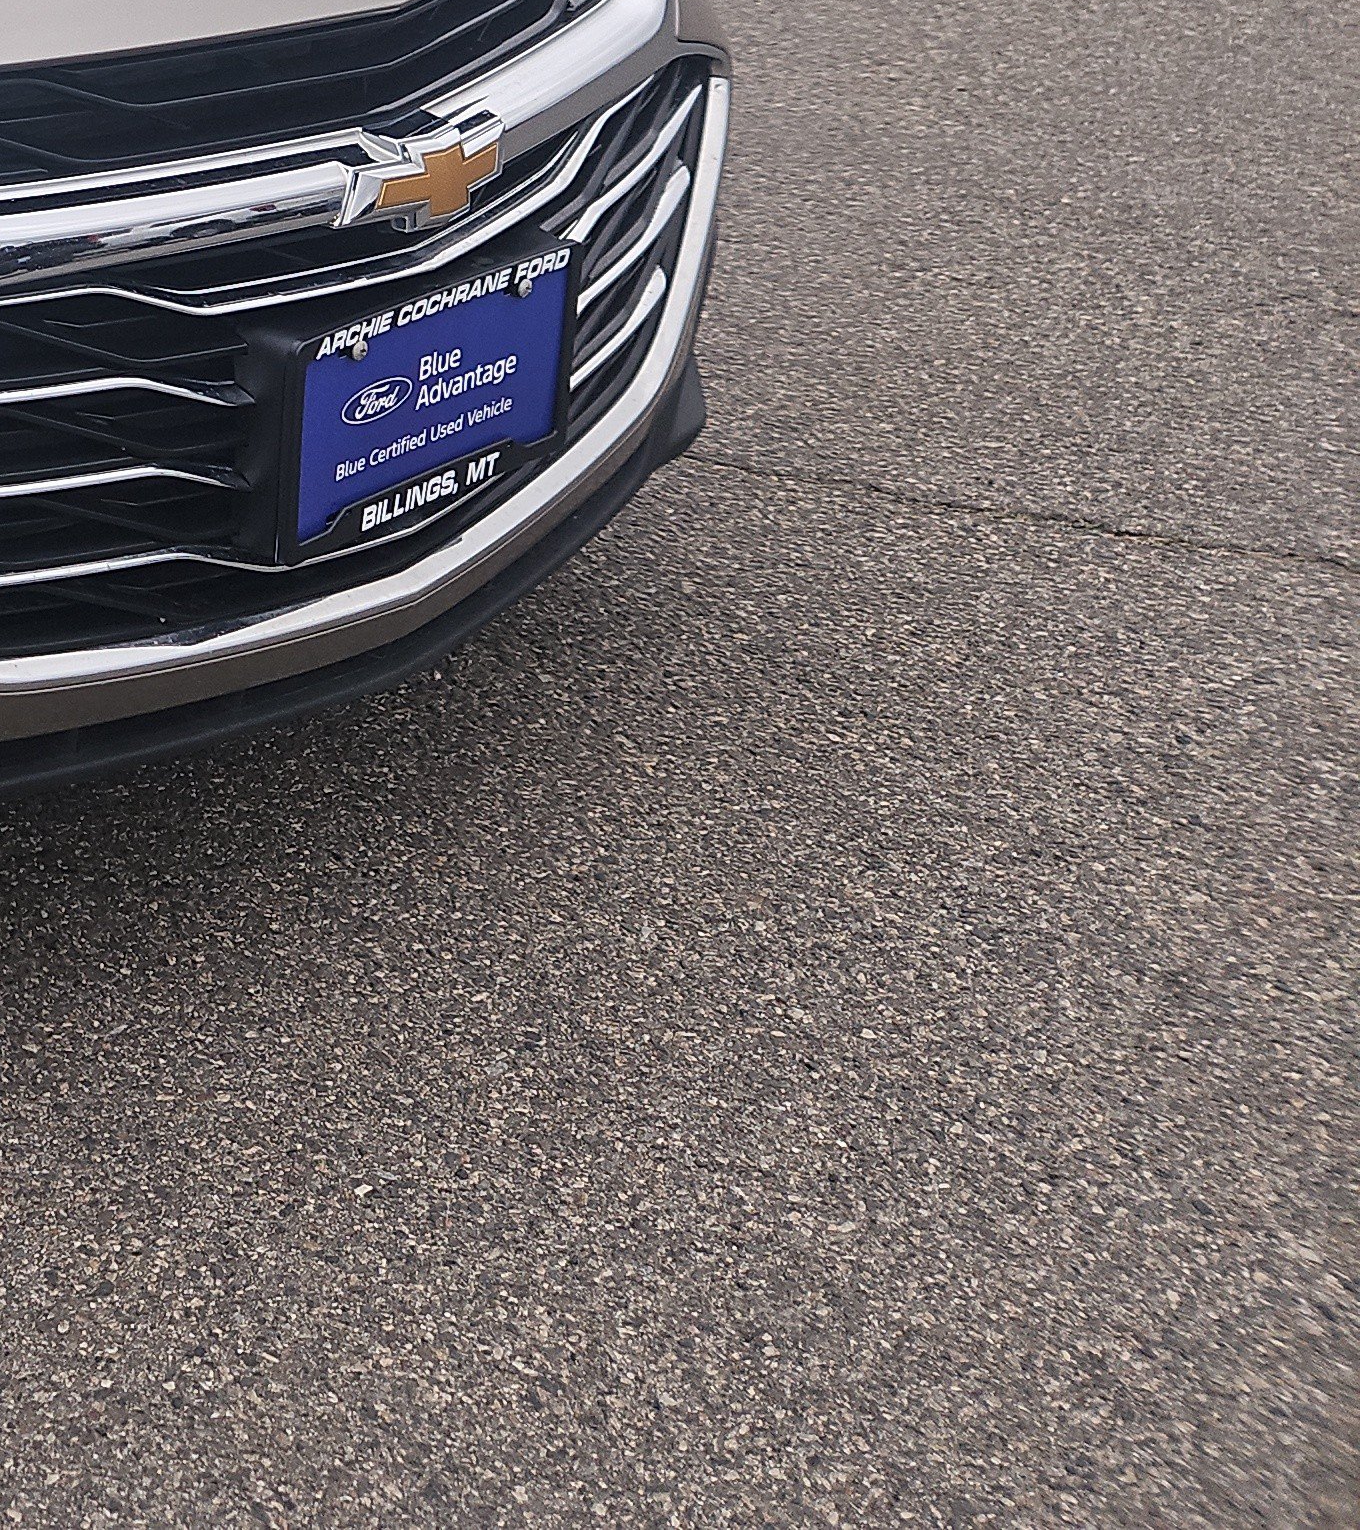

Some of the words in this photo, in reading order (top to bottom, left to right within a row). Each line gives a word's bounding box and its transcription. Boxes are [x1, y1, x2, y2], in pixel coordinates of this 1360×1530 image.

[315, 312, 394, 360] ARCHIE
[397, 268, 513, 327] COCHRANE
[514, 248, 571, 285] FORD
[415, 355, 517, 410] Advantage
[419, 348, 461, 381] Blue
[335, 458, 365, 481] Blue
[369, 429, 426, 466] Certified
[430, 417, 463, 443] Used
[467, 397, 512, 427] Vehicle
[361, 470, 459, 531] BILLINGS,
[465, 452, 500, 486] MT
